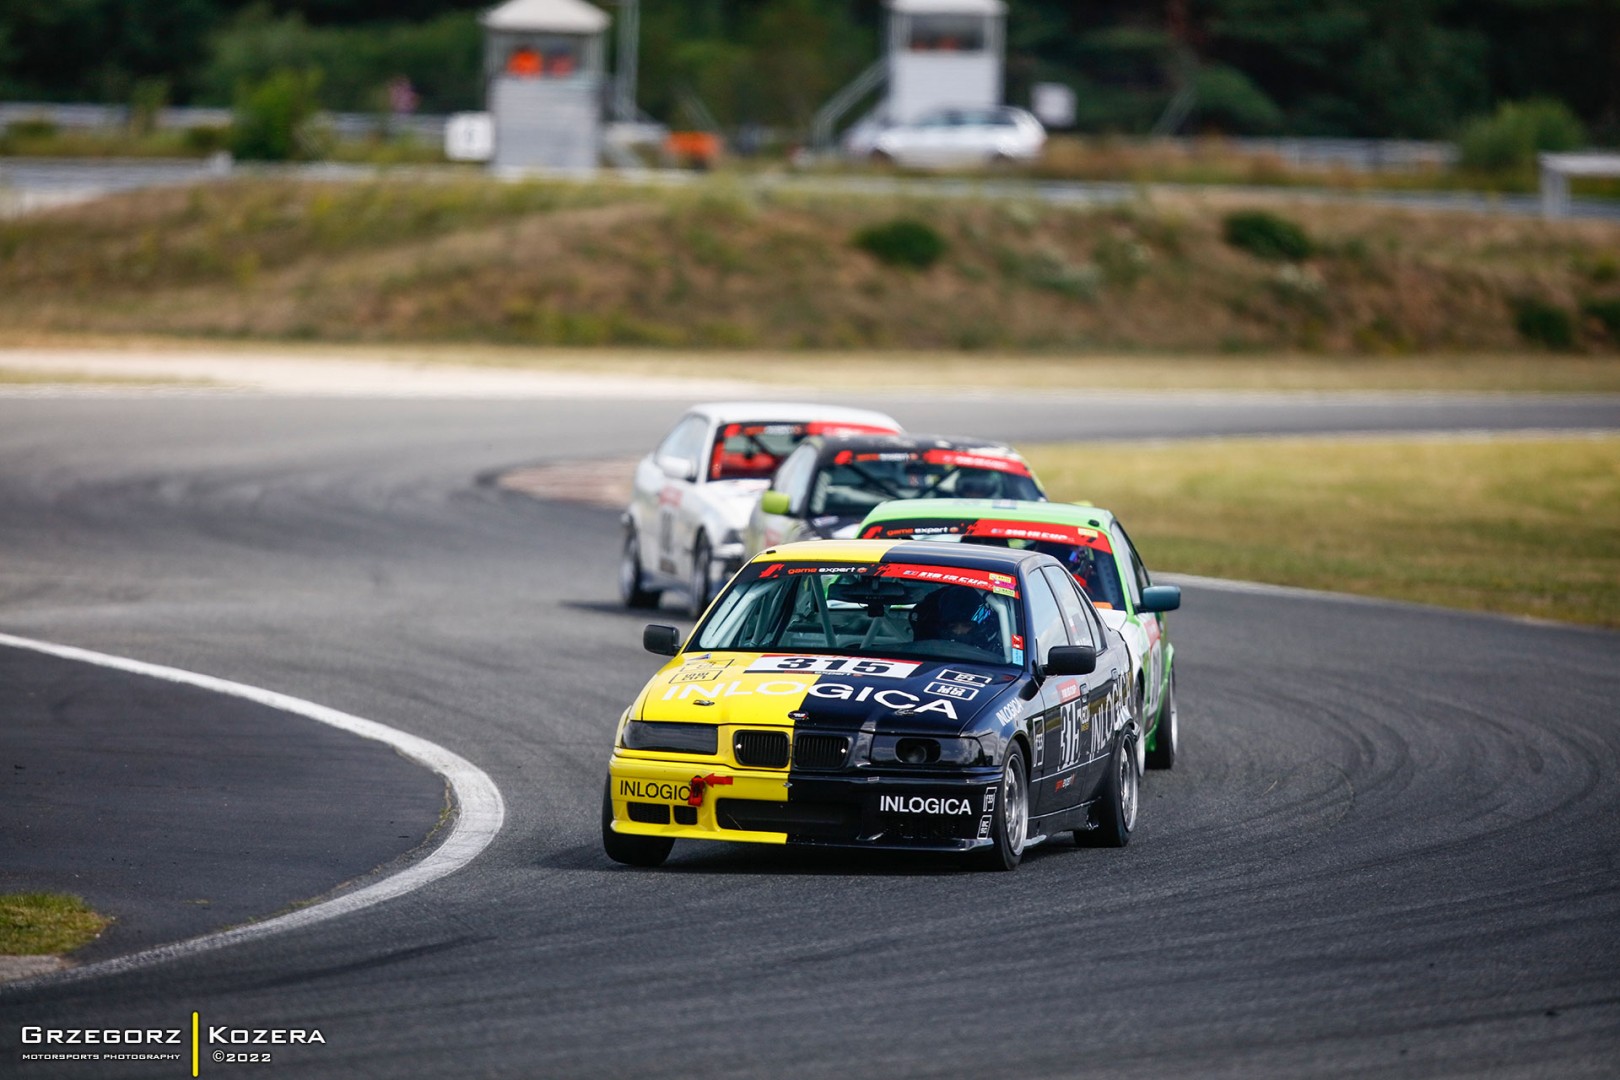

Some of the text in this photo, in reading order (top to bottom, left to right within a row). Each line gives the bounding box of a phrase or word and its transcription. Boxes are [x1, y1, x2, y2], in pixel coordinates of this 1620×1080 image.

[914, 526, 948, 534] expert
[787, 567, 818, 575] game
[777, 658, 895, 674] 315
[661, 680, 958, 720] INLOGICA
[995, 697, 1024, 727] INLOGICA
[620, 779, 692, 801] INLOGIC
[879, 795, 972, 815] INLOGICA
